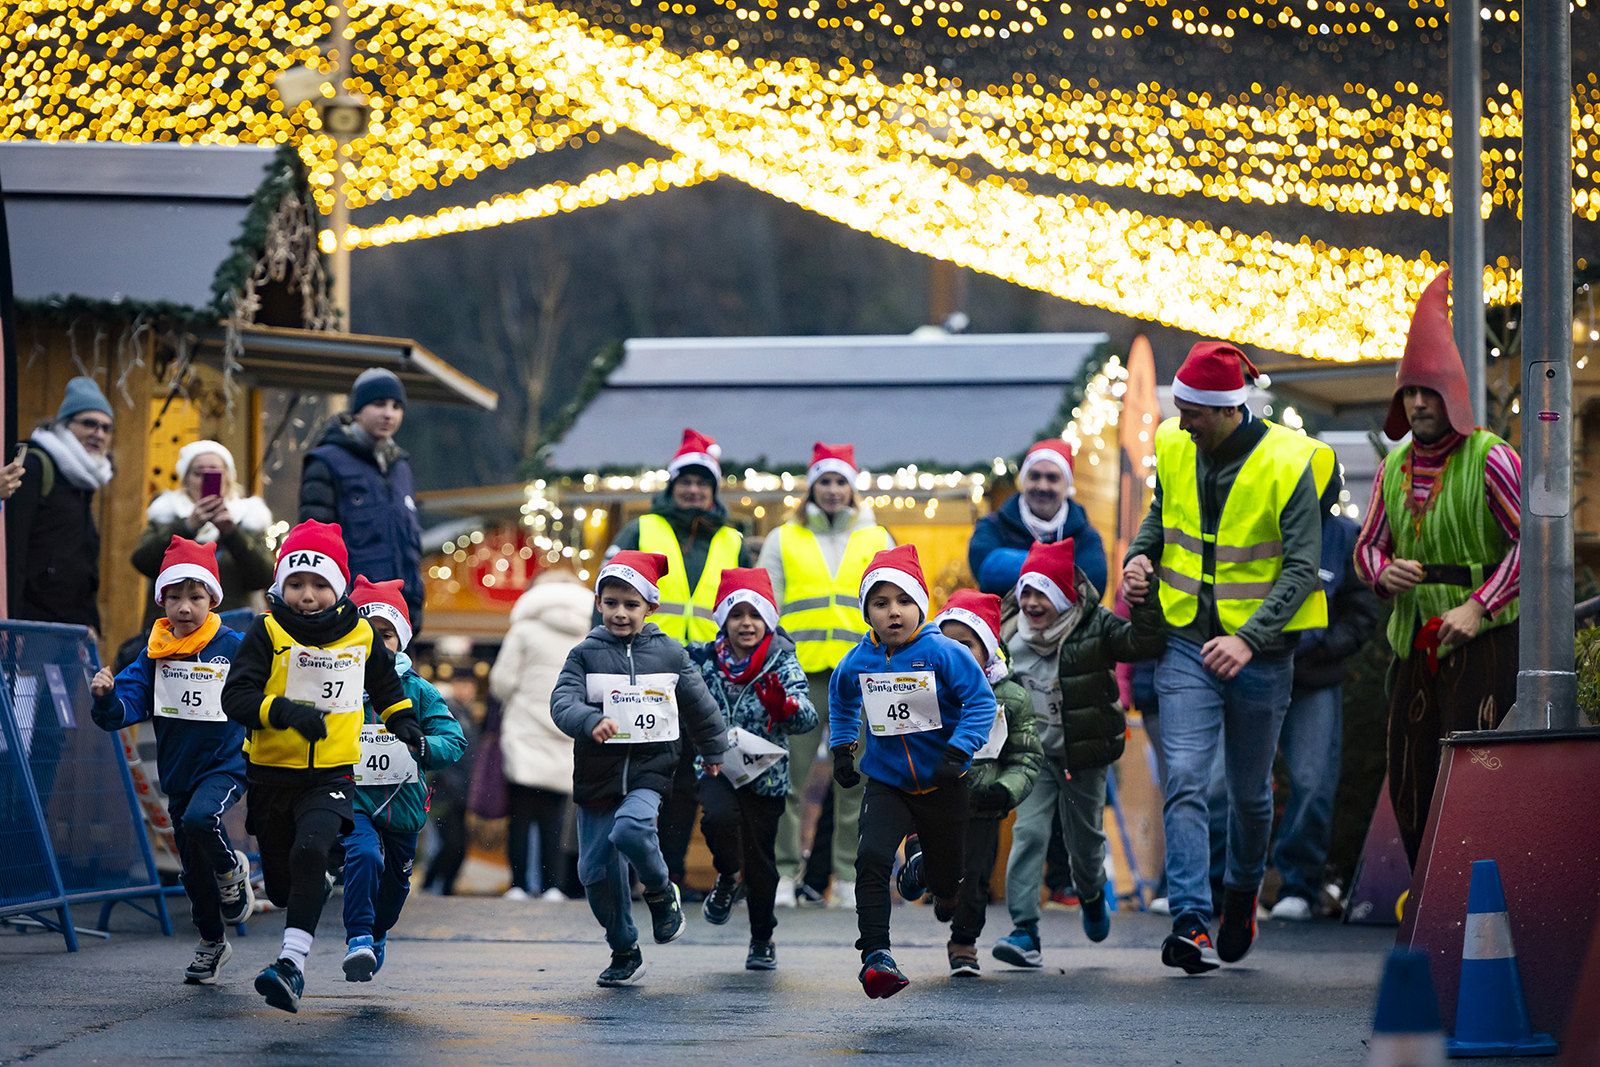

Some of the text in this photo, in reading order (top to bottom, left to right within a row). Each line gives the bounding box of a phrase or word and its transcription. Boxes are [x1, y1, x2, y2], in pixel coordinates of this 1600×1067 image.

[288, 553, 325, 568] FAF
[299, 657, 333, 670] Santa
[162, 668, 189, 680] Santa
[321, 681, 344, 699] 37
[867, 683, 892, 693] Santa
[181, 690, 202, 707] 45
[611, 694, 641, 704] Santa
[887, 703, 910, 720] 48
[1048, 700, 1062, 715] 3
[634, 714, 655, 729] 49
[366, 754, 390, 771] 40
